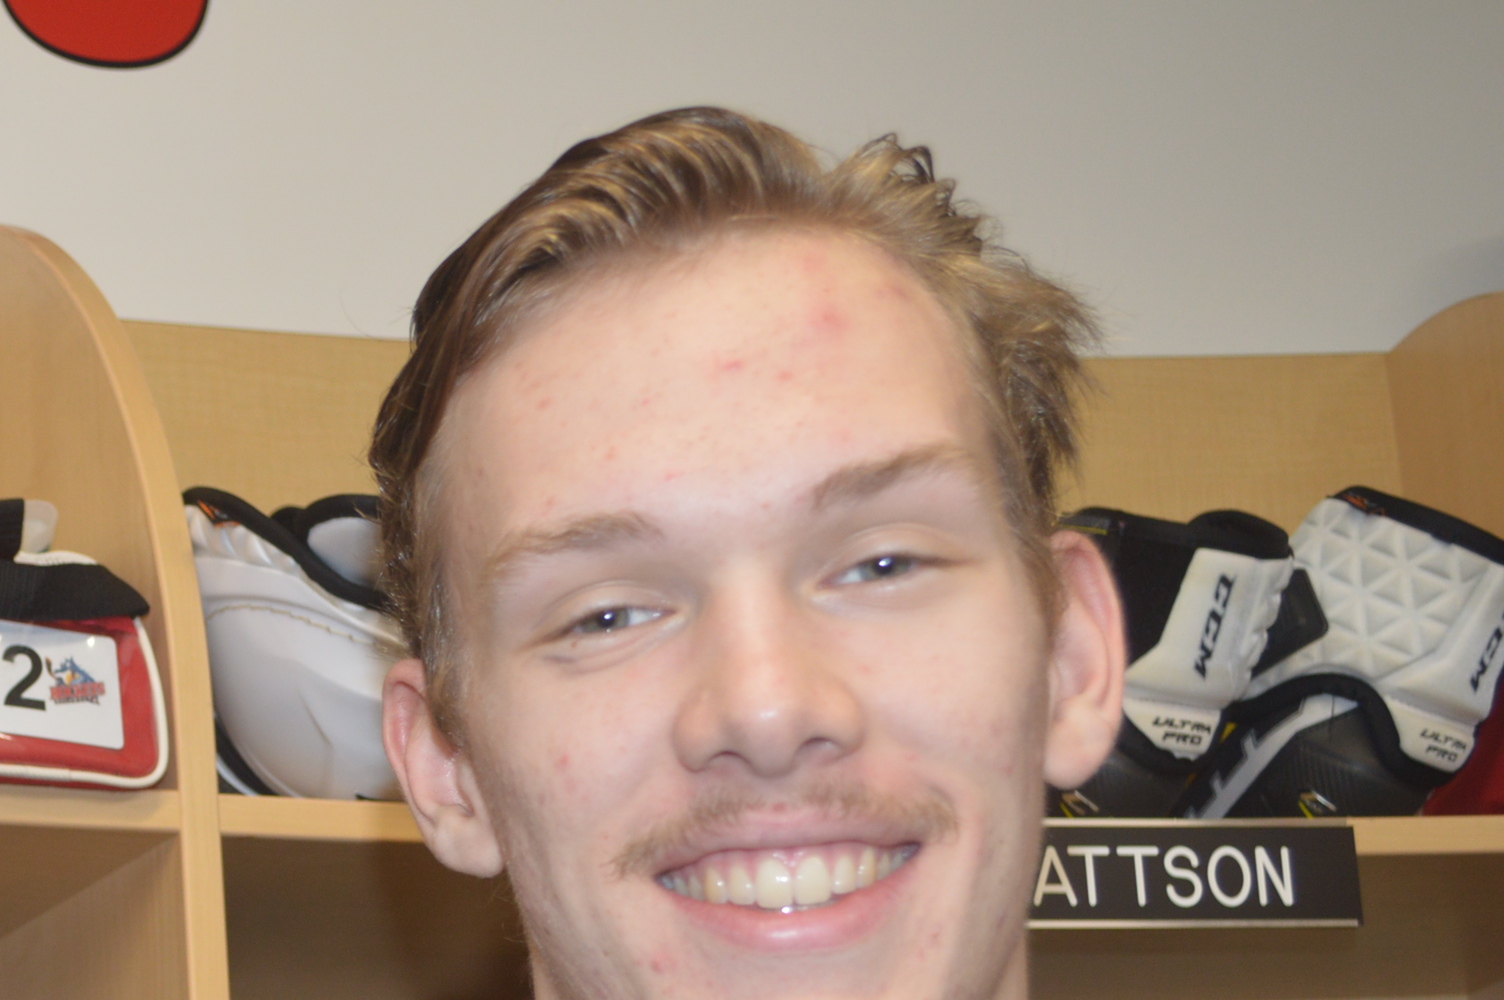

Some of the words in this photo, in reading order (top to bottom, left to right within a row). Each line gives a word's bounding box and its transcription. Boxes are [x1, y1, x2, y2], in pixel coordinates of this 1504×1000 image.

[1193, 573, 1236, 680] CCM
[1470, 608, 1504, 693] CM
[1152, 716, 1212, 734] ULTRA
[1162, 731, 1203, 745] PRO
[1033, 845, 1295, 908] ATTSON
